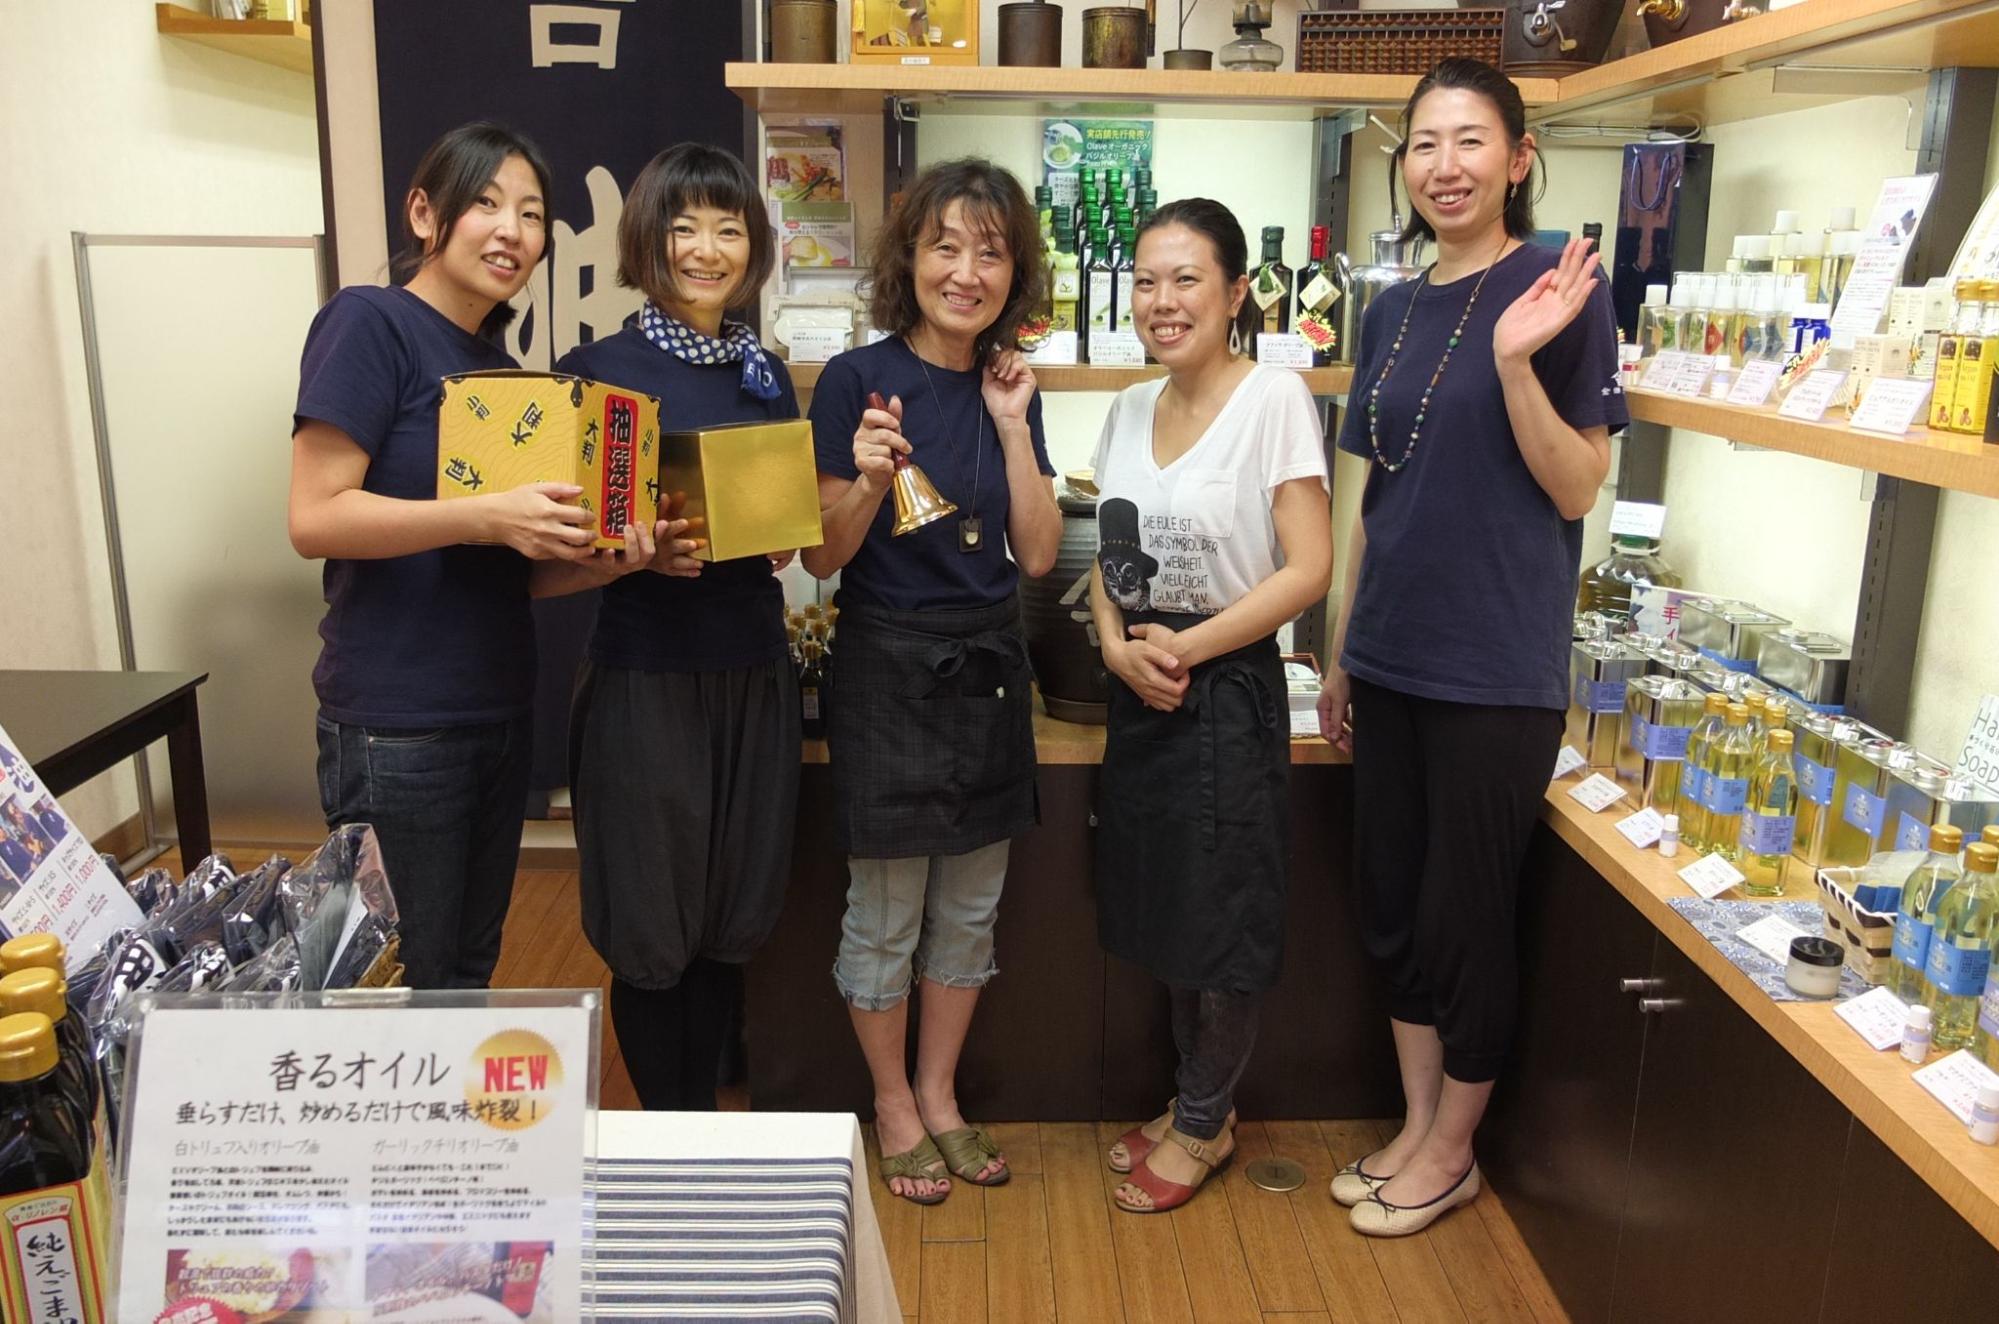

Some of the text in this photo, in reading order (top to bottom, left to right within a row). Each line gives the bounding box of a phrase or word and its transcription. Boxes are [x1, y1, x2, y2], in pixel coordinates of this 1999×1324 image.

[510, 401, 544, 448] 大判
[582, 417, 600, 467] 大判
[444, 457, 485, 491] 大判
[1149, 534, 1164, 549] DAS
[1179, 518, 1192, 532] IST
[269, 1050, 451, 1092] 香るオイル
[484, 1055, 548, 1093] NEW
